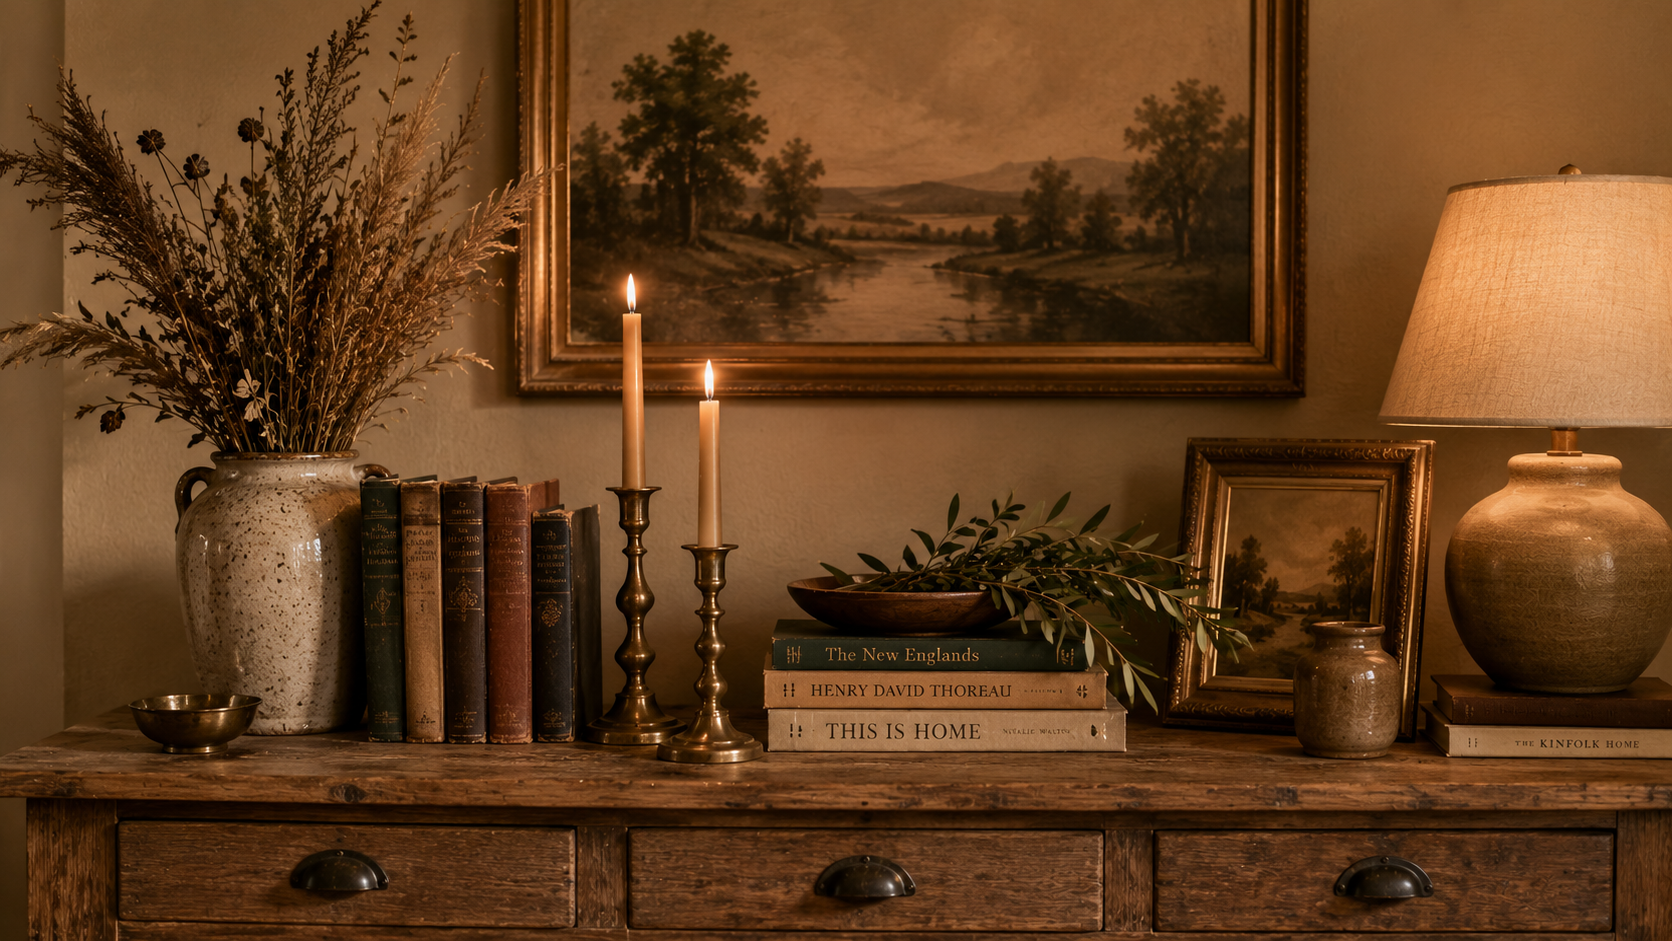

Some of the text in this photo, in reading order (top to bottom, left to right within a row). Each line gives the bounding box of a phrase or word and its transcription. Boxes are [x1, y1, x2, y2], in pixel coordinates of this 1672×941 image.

[825, 647, 980, 666] The New Englands
[811, 684, 868, 697] HENRY
[874, 684, 925, 697] DAVID
[929, 684, 1012, 698] THOREAU
[826, 723, 981, 740] THIS IS HOME
[1540, 739, 1600, 749] KINFOLK
[1606, 740, 1640, 749] HOME
